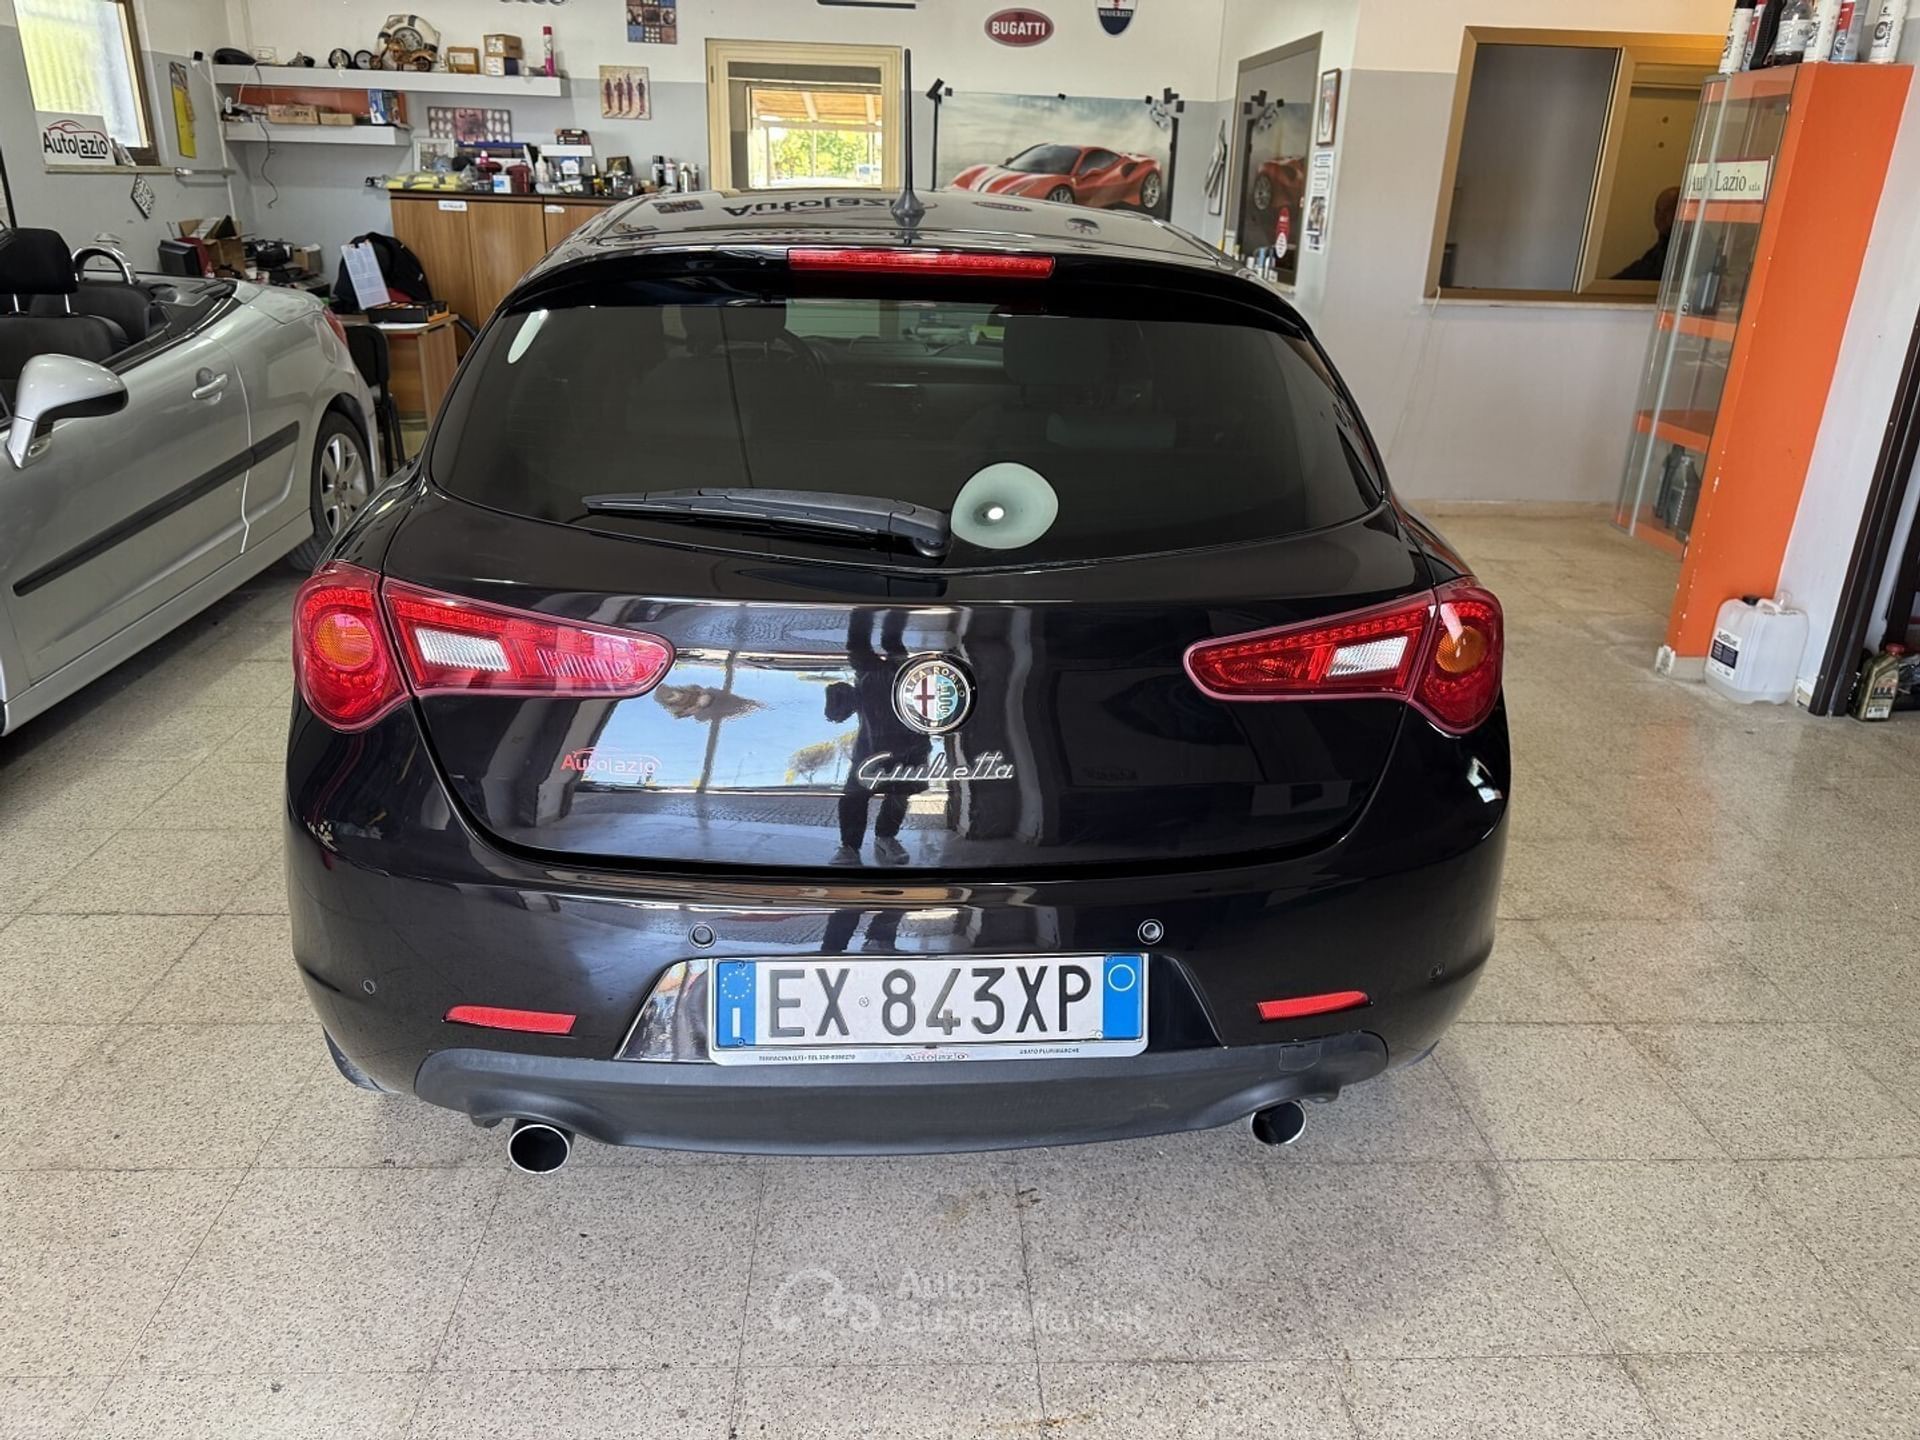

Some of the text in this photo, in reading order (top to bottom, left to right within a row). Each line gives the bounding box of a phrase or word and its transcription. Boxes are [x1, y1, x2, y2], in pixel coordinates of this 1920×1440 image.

[991, 21, 1046, 36] BUGATTI
[43, 131, 108, 159] Autolazio
[1714, 169, 1747, 192] Lazio
[561, 754, 656, 776] Autolazio
[858, 751, 1014, 790] Giulietta
[768, 964, 1092, 1038] EX 843XP
